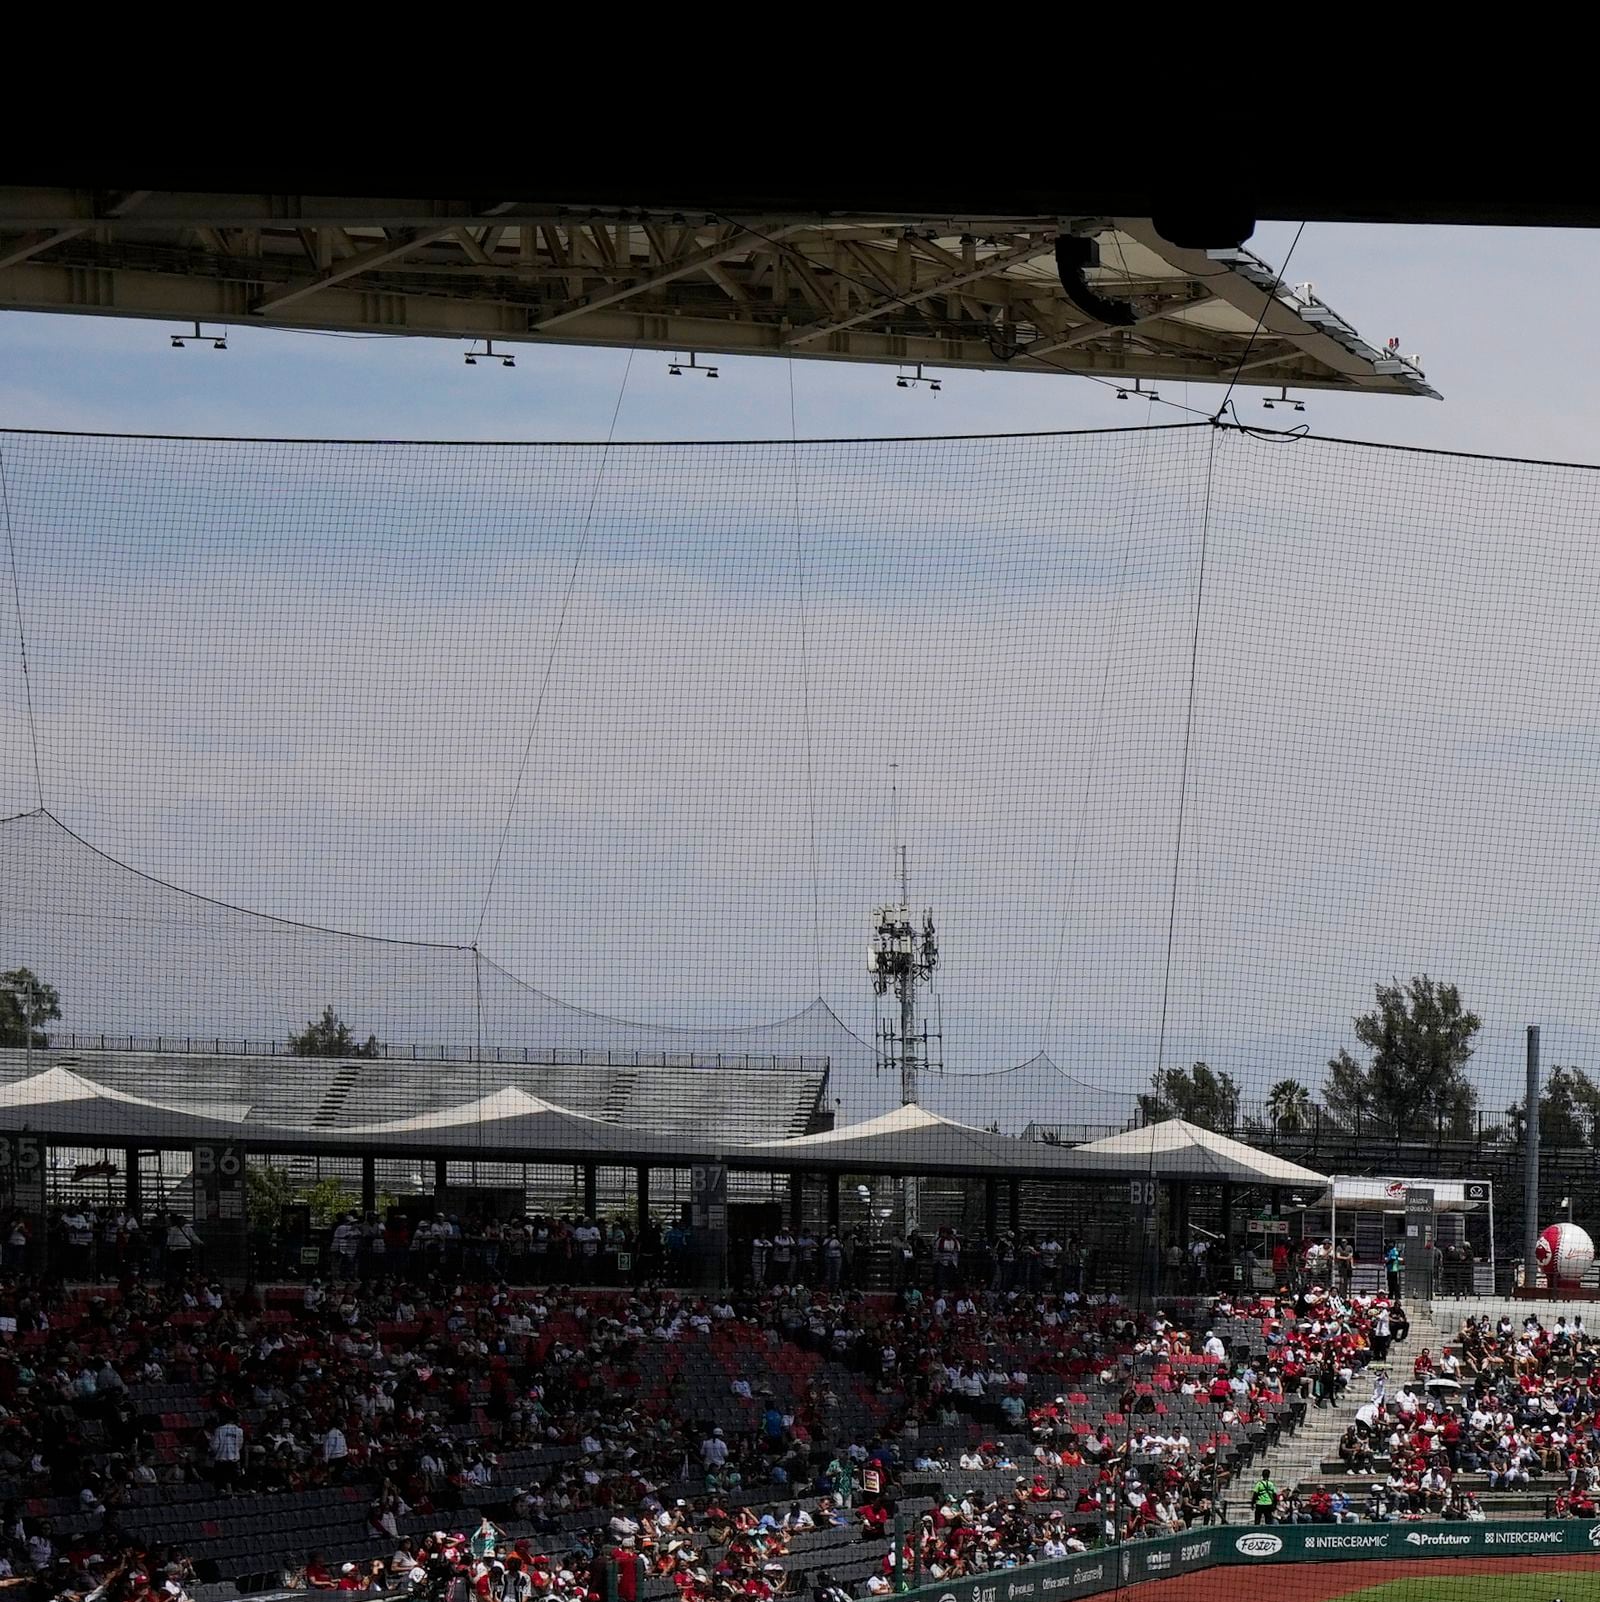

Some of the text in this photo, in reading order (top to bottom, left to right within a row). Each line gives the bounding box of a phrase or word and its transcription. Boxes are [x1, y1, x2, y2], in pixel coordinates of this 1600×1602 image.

[194, 1147, 241, 1175] B6
[691, 1166, 722, 1192] B7
[1130, 1181, 1155, 1205] B8
[1316, 1535, 1388, 1548] INTERCERAMIC
[1421, 1533, 1470, 1546] Profuturo
[1495, 1531, 1563, 1543] INTERCERAMIC
[1241, 1538, 1277, 1551] Fester
